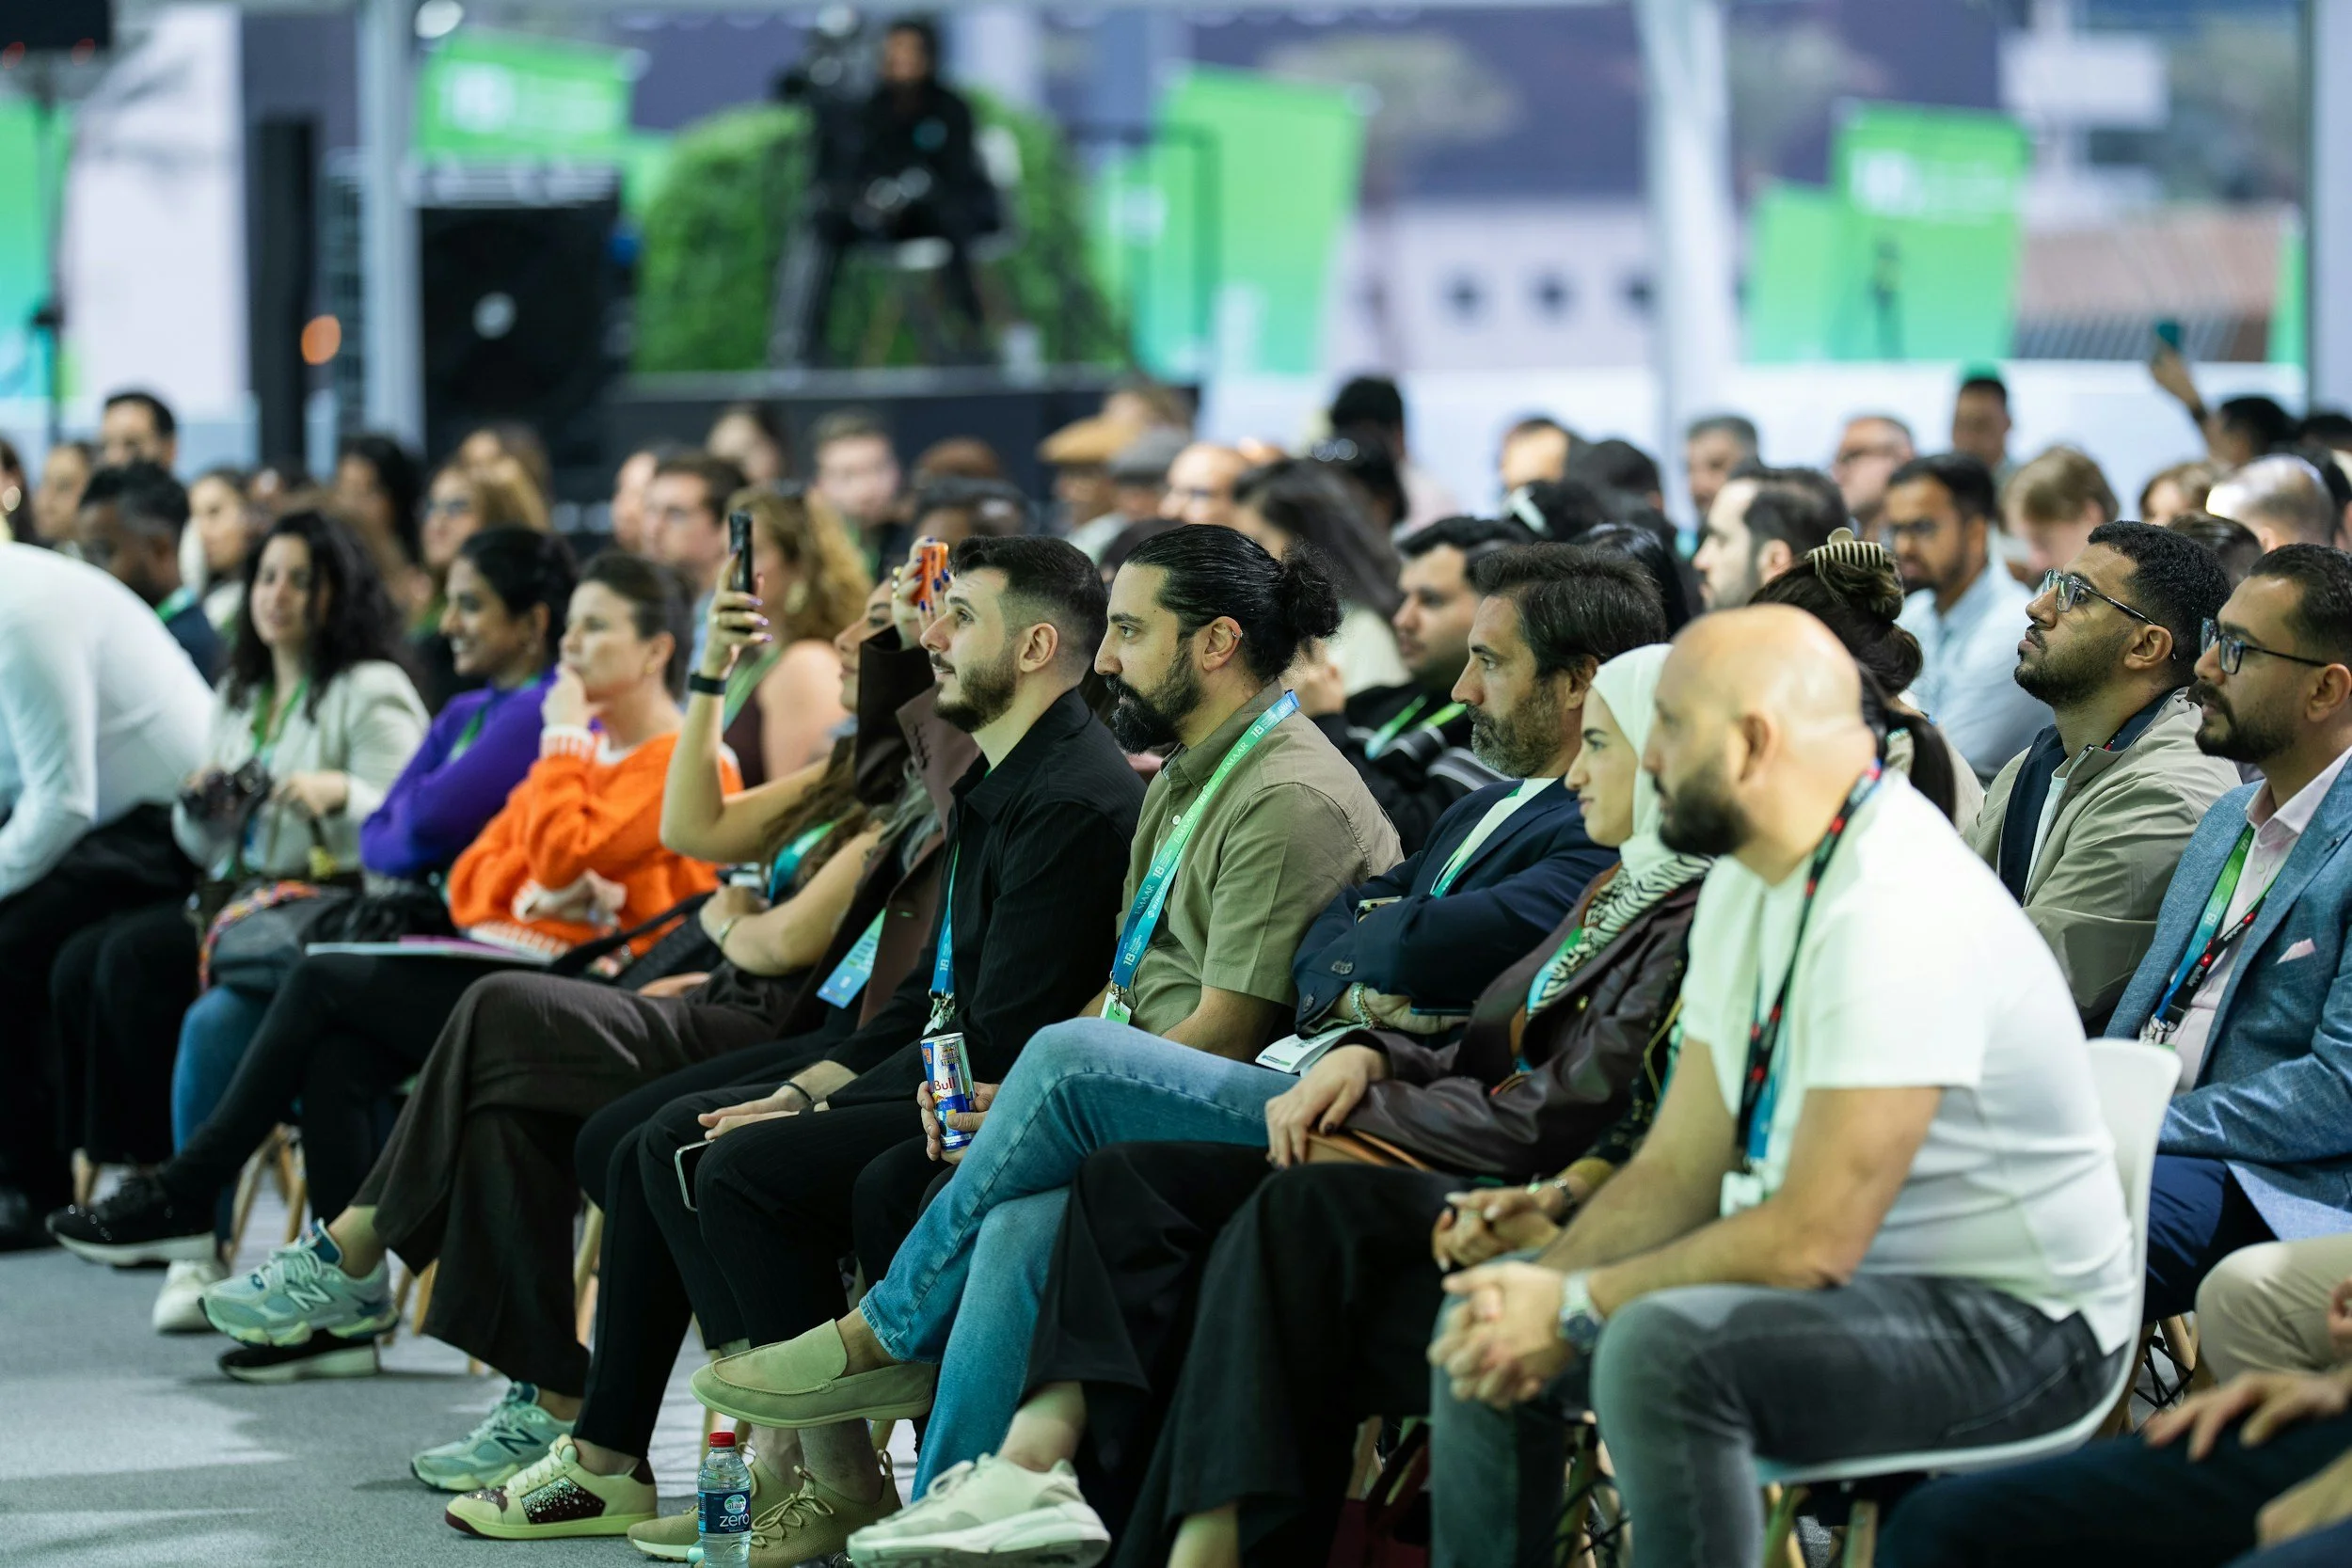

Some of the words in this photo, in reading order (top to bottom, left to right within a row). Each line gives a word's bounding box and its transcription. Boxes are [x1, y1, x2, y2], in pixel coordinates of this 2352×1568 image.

[1251, 725, 1264, 738] 1B
[1223, 741, 1248, 772] EMAAR
[1173, 811, 1197, 845] EMAAR
[1152, 863, 1166, 879] 1B
[1135, 884, 1155, 914] EMAAR
[1152, 876, 1170, 911] BINANCE
[2203, 912, 2217, 927] 1B
[939, 958, 950, 972] 1B
[1122, 952, 1136, 966] 1B
[934, 1077, 957, 1091] Bull
[720, 1513, 750, 1528] zero
